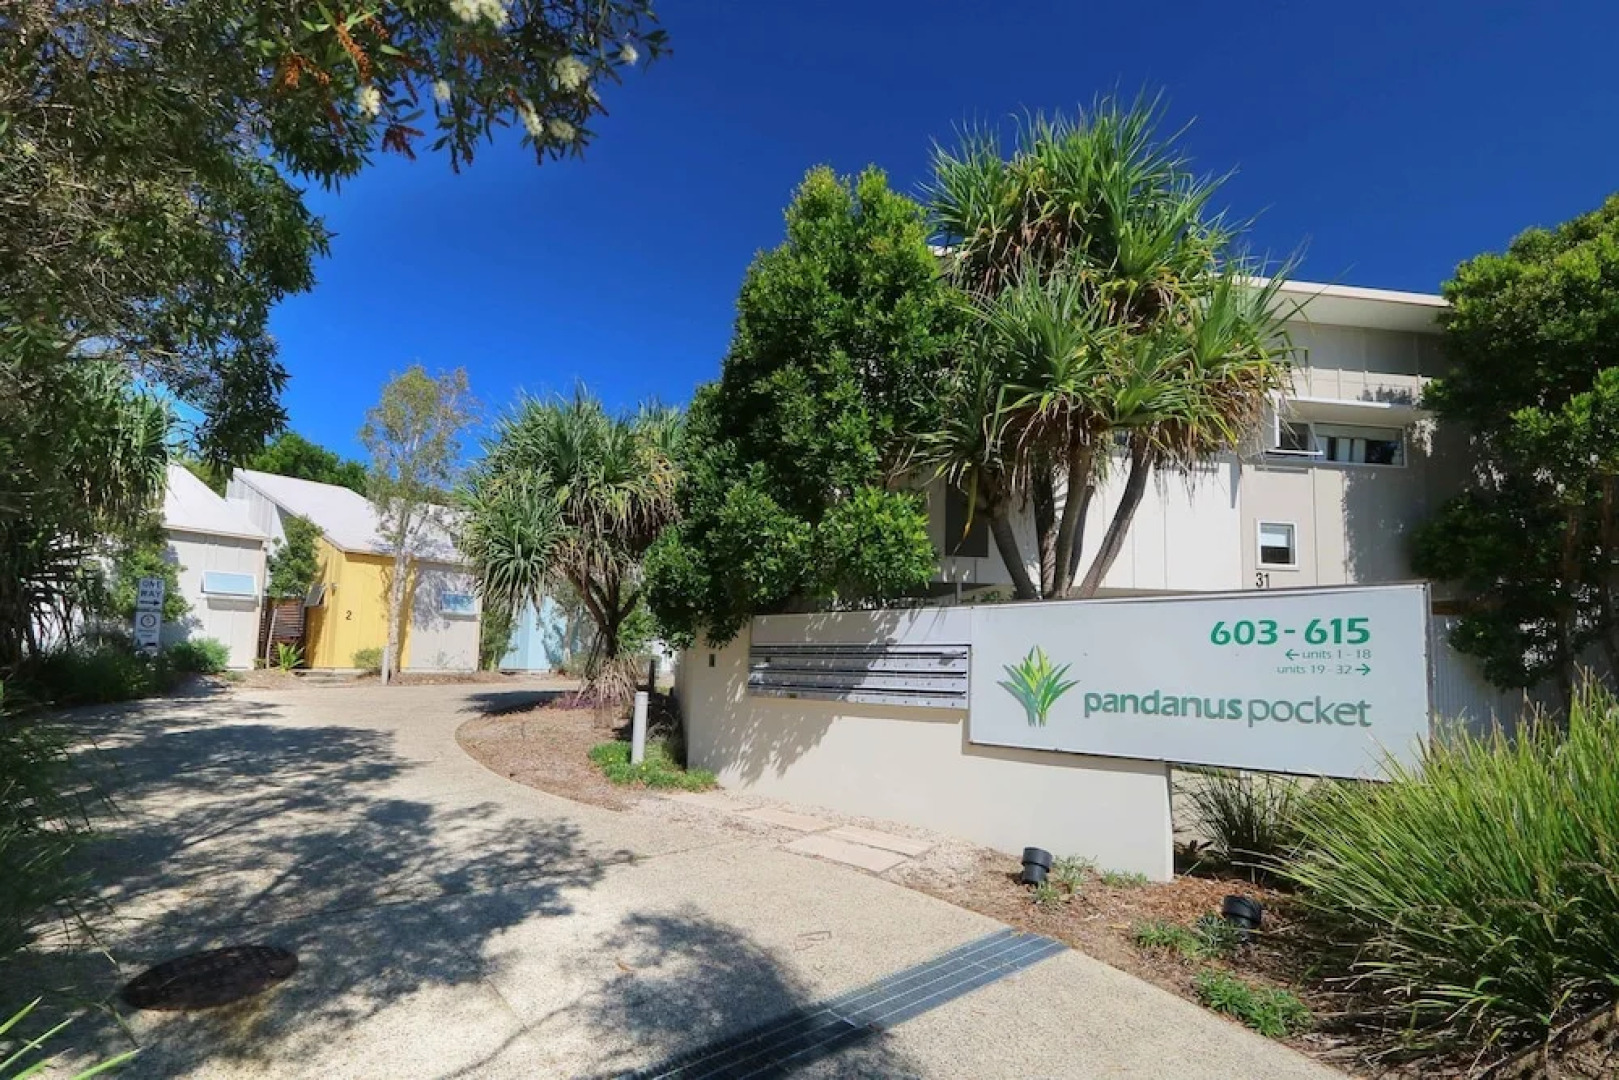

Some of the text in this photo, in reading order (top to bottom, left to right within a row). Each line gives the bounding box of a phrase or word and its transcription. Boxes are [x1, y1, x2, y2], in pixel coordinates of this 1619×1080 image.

[1255, 572, 1270, 588] 31
[141, 590, 162, 598] WAY
[345, 610, 352, 621] 2
[1210, 619, 1279, 646] 603
[1304, 616, 1371, 645] 615
[1302, 648, 1332, 660] units
[1356, 649, 1372, 660] 18
[1276, 664, 1306, 675] units
[1310, 664, 1325, 675] 19
[1336, 664, 1352, 675] 32
[1083, 689, 1373, 728] pandanus pocket
